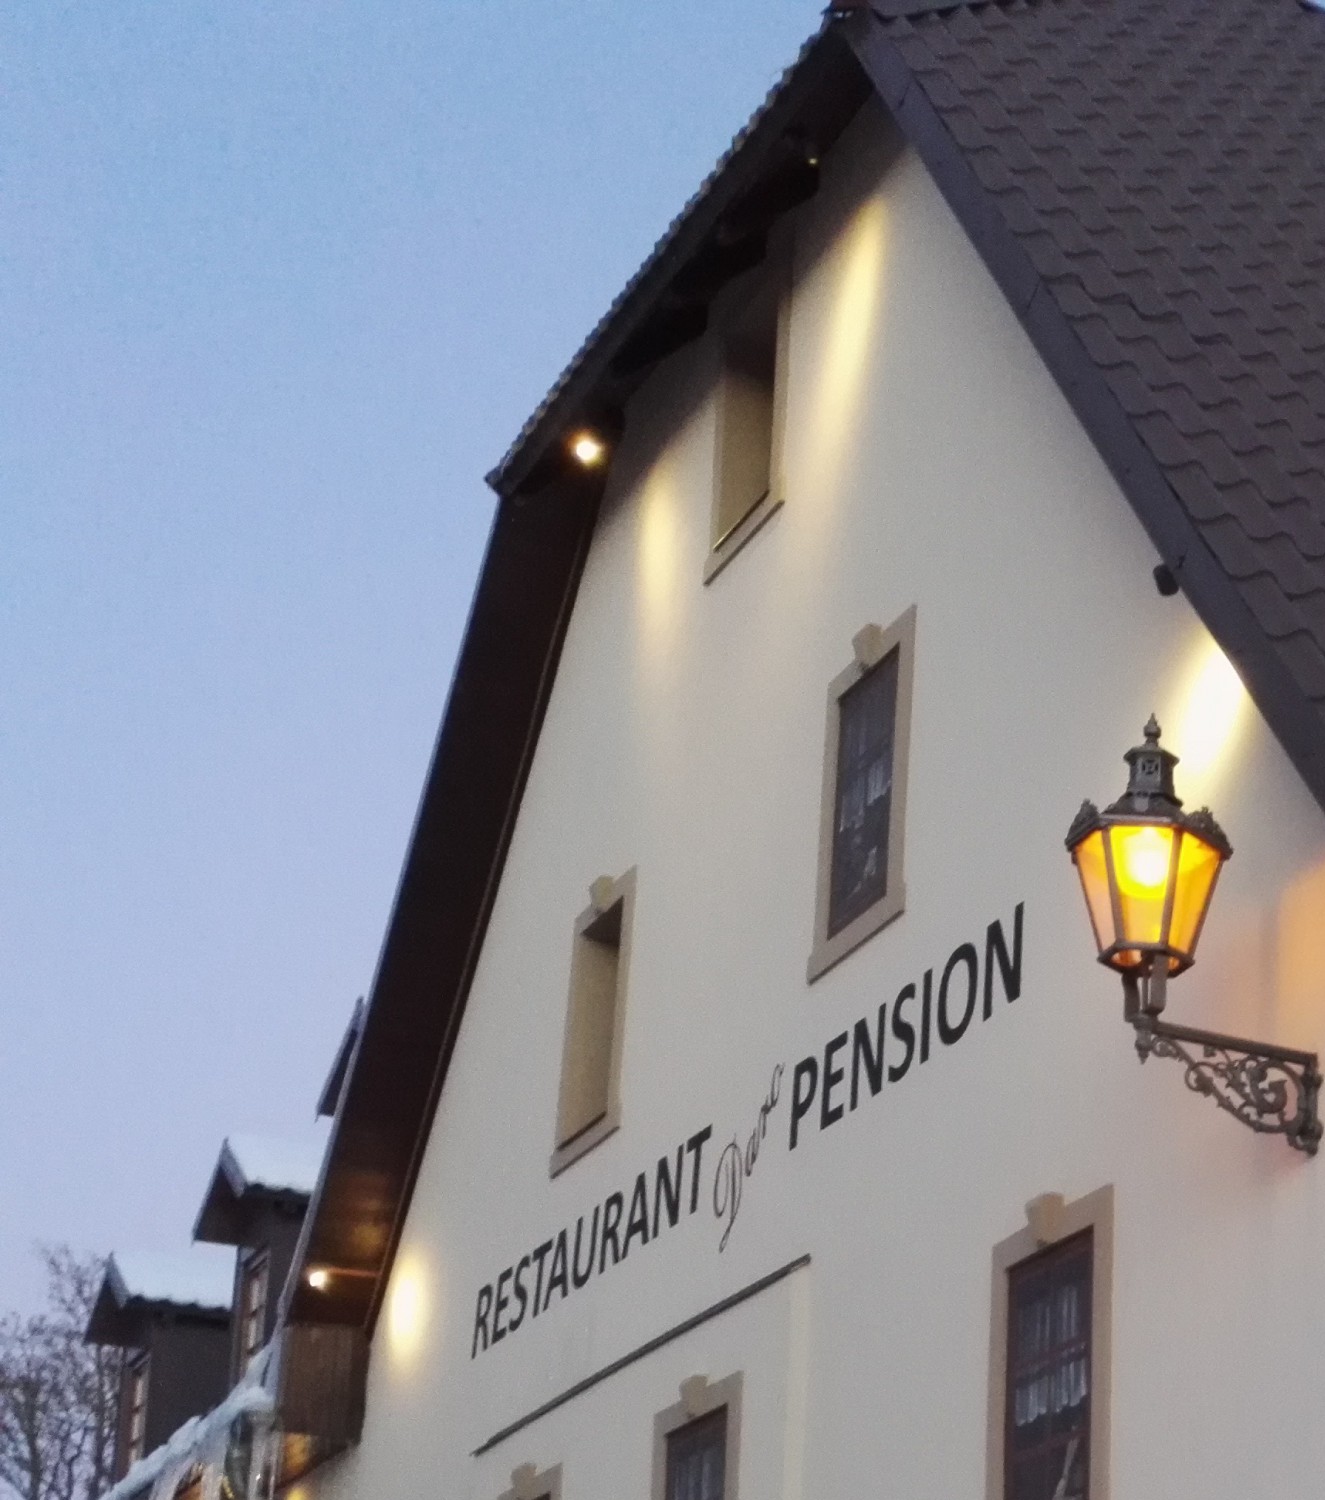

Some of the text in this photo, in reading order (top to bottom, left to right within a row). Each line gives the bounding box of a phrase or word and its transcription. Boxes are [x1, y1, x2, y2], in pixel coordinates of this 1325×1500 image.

[472, 902, 1024, 1358] RESTAURANT Daro PENSION
